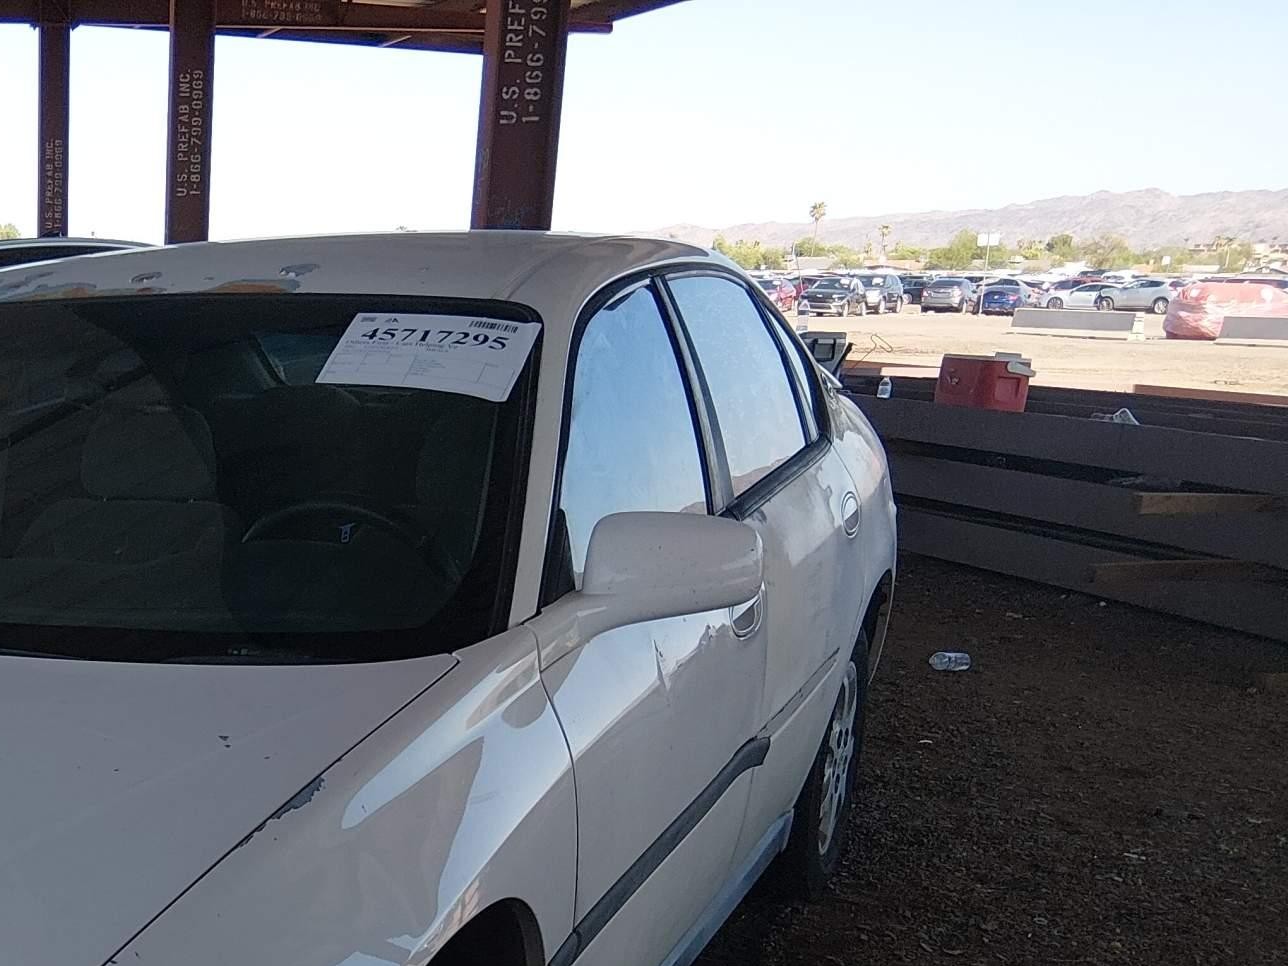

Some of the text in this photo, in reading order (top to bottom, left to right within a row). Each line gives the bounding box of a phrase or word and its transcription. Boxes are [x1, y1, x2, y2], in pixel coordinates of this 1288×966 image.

[499, 79, 520, 124] U.S.
[175, 69, 191, 197] U.S. PREFAB INC.
[189, 70, 204, 195] 1-866-799-0969
[44, 163, 54, 205] PREFAB
[361, 327, 510, 351] 45717295
